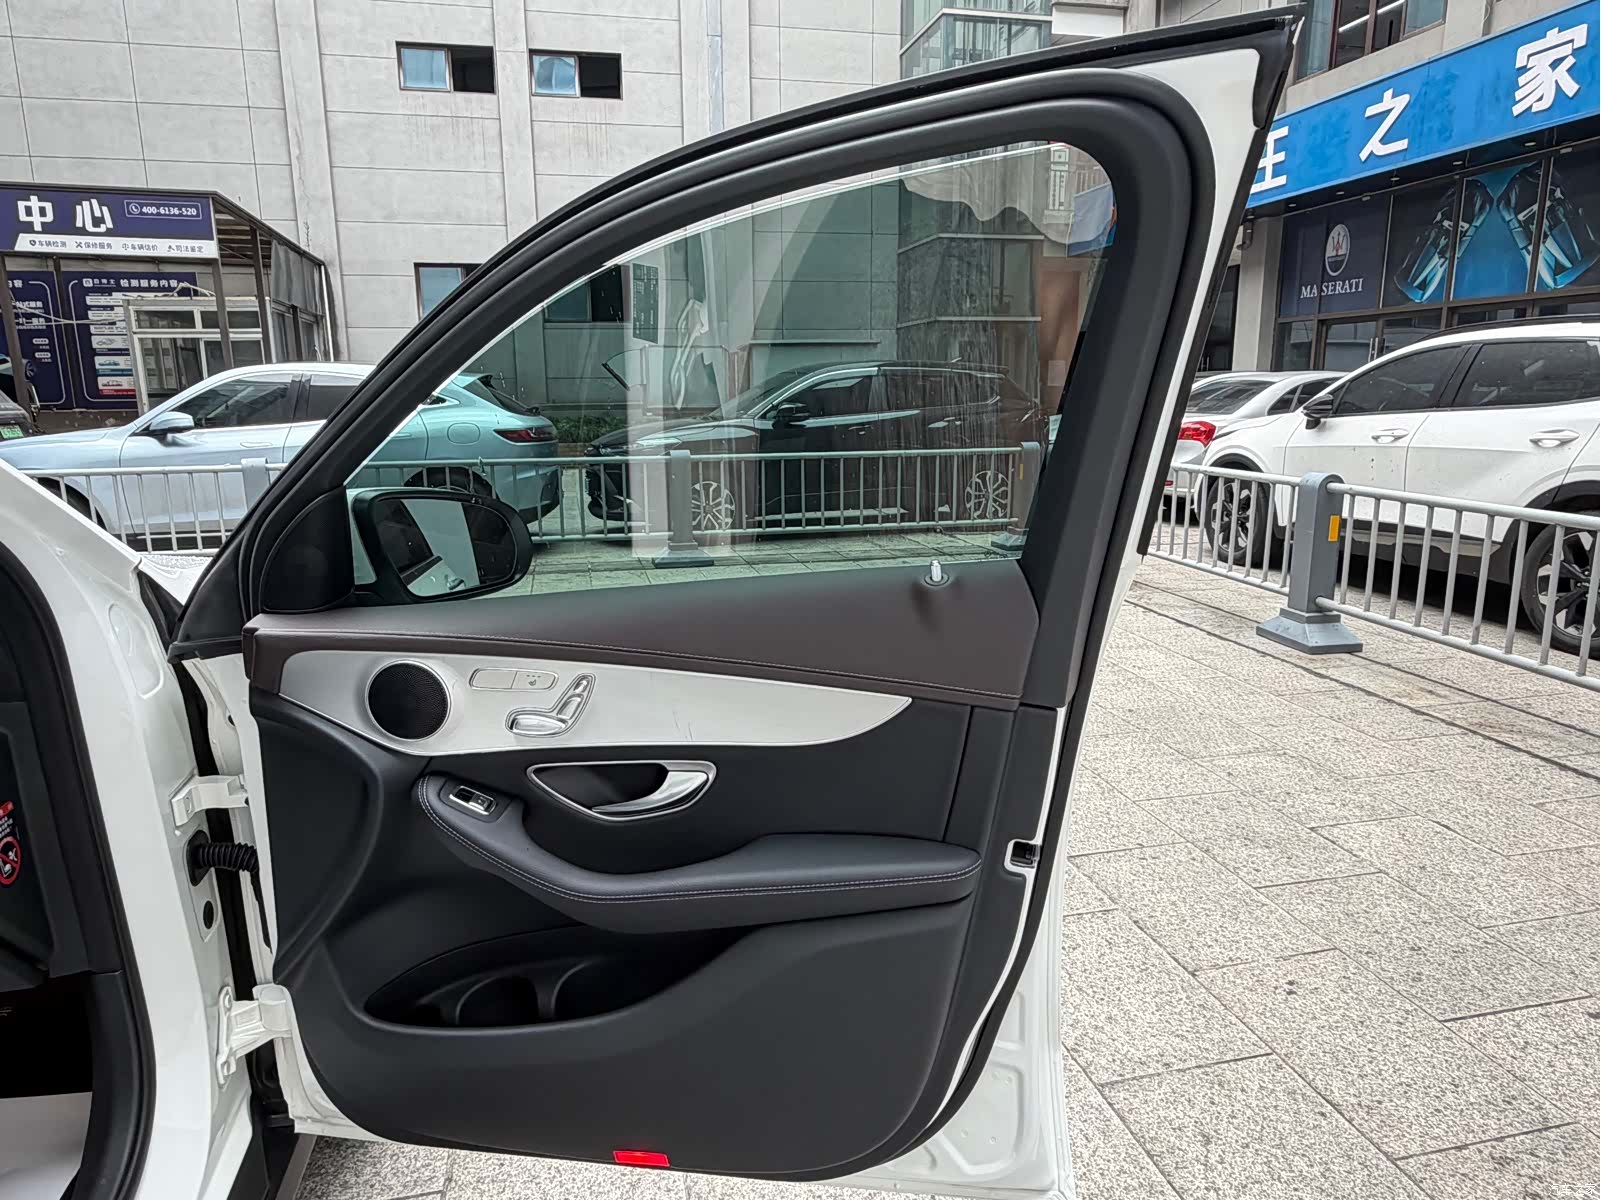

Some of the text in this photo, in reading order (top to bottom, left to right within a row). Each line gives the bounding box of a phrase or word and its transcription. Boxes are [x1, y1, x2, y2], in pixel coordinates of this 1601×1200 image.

[17, 195, 114, 233] 中心
[141, 205, 197, 216] 400-6136-520
[37, 239, 204, 253] 车辆检测 保修服务 车辆估价 司法鉴定
[120, 279, 178, 288] 检测服务内容
